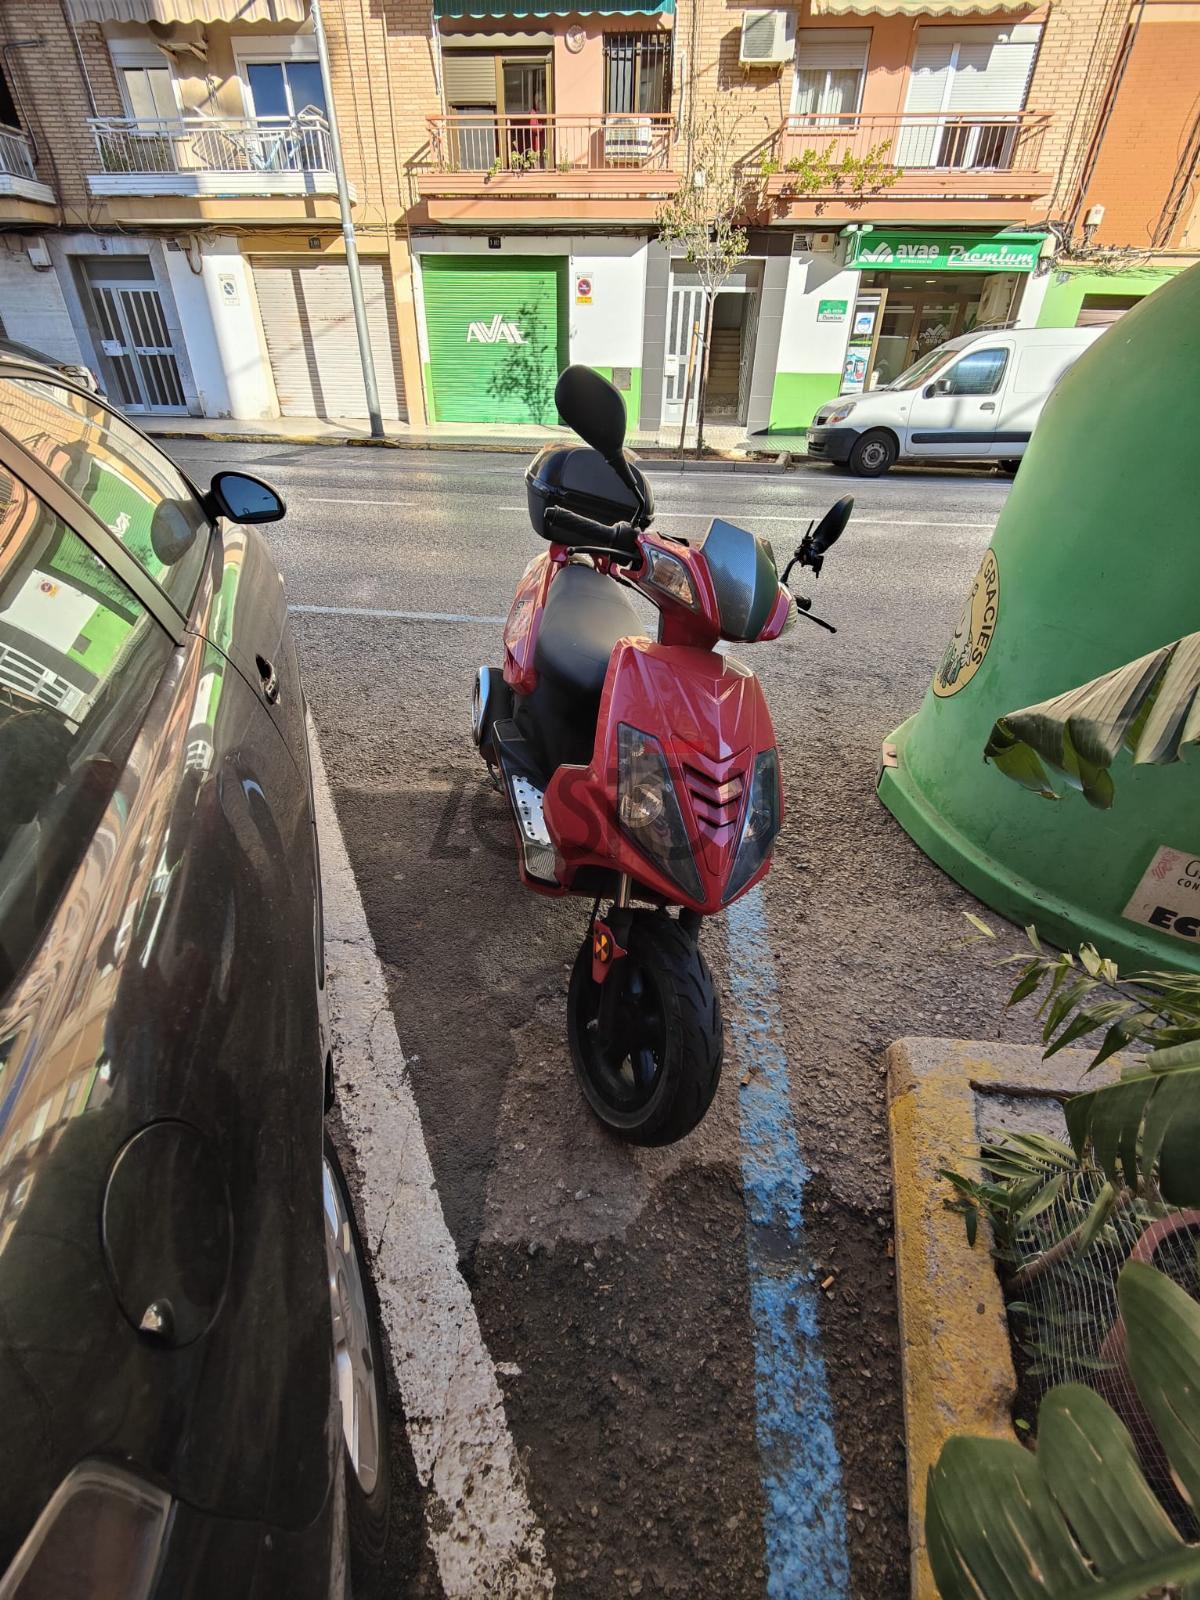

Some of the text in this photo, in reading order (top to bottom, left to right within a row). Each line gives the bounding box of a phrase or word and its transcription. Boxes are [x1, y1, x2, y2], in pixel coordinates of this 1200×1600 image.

[896, 244, 1035, 267] avae Premium
[972, 558, 997, 666] GRACIES
[1177, 877, 1200, 891] CON
[1148, 905, 1200, 937] EC
